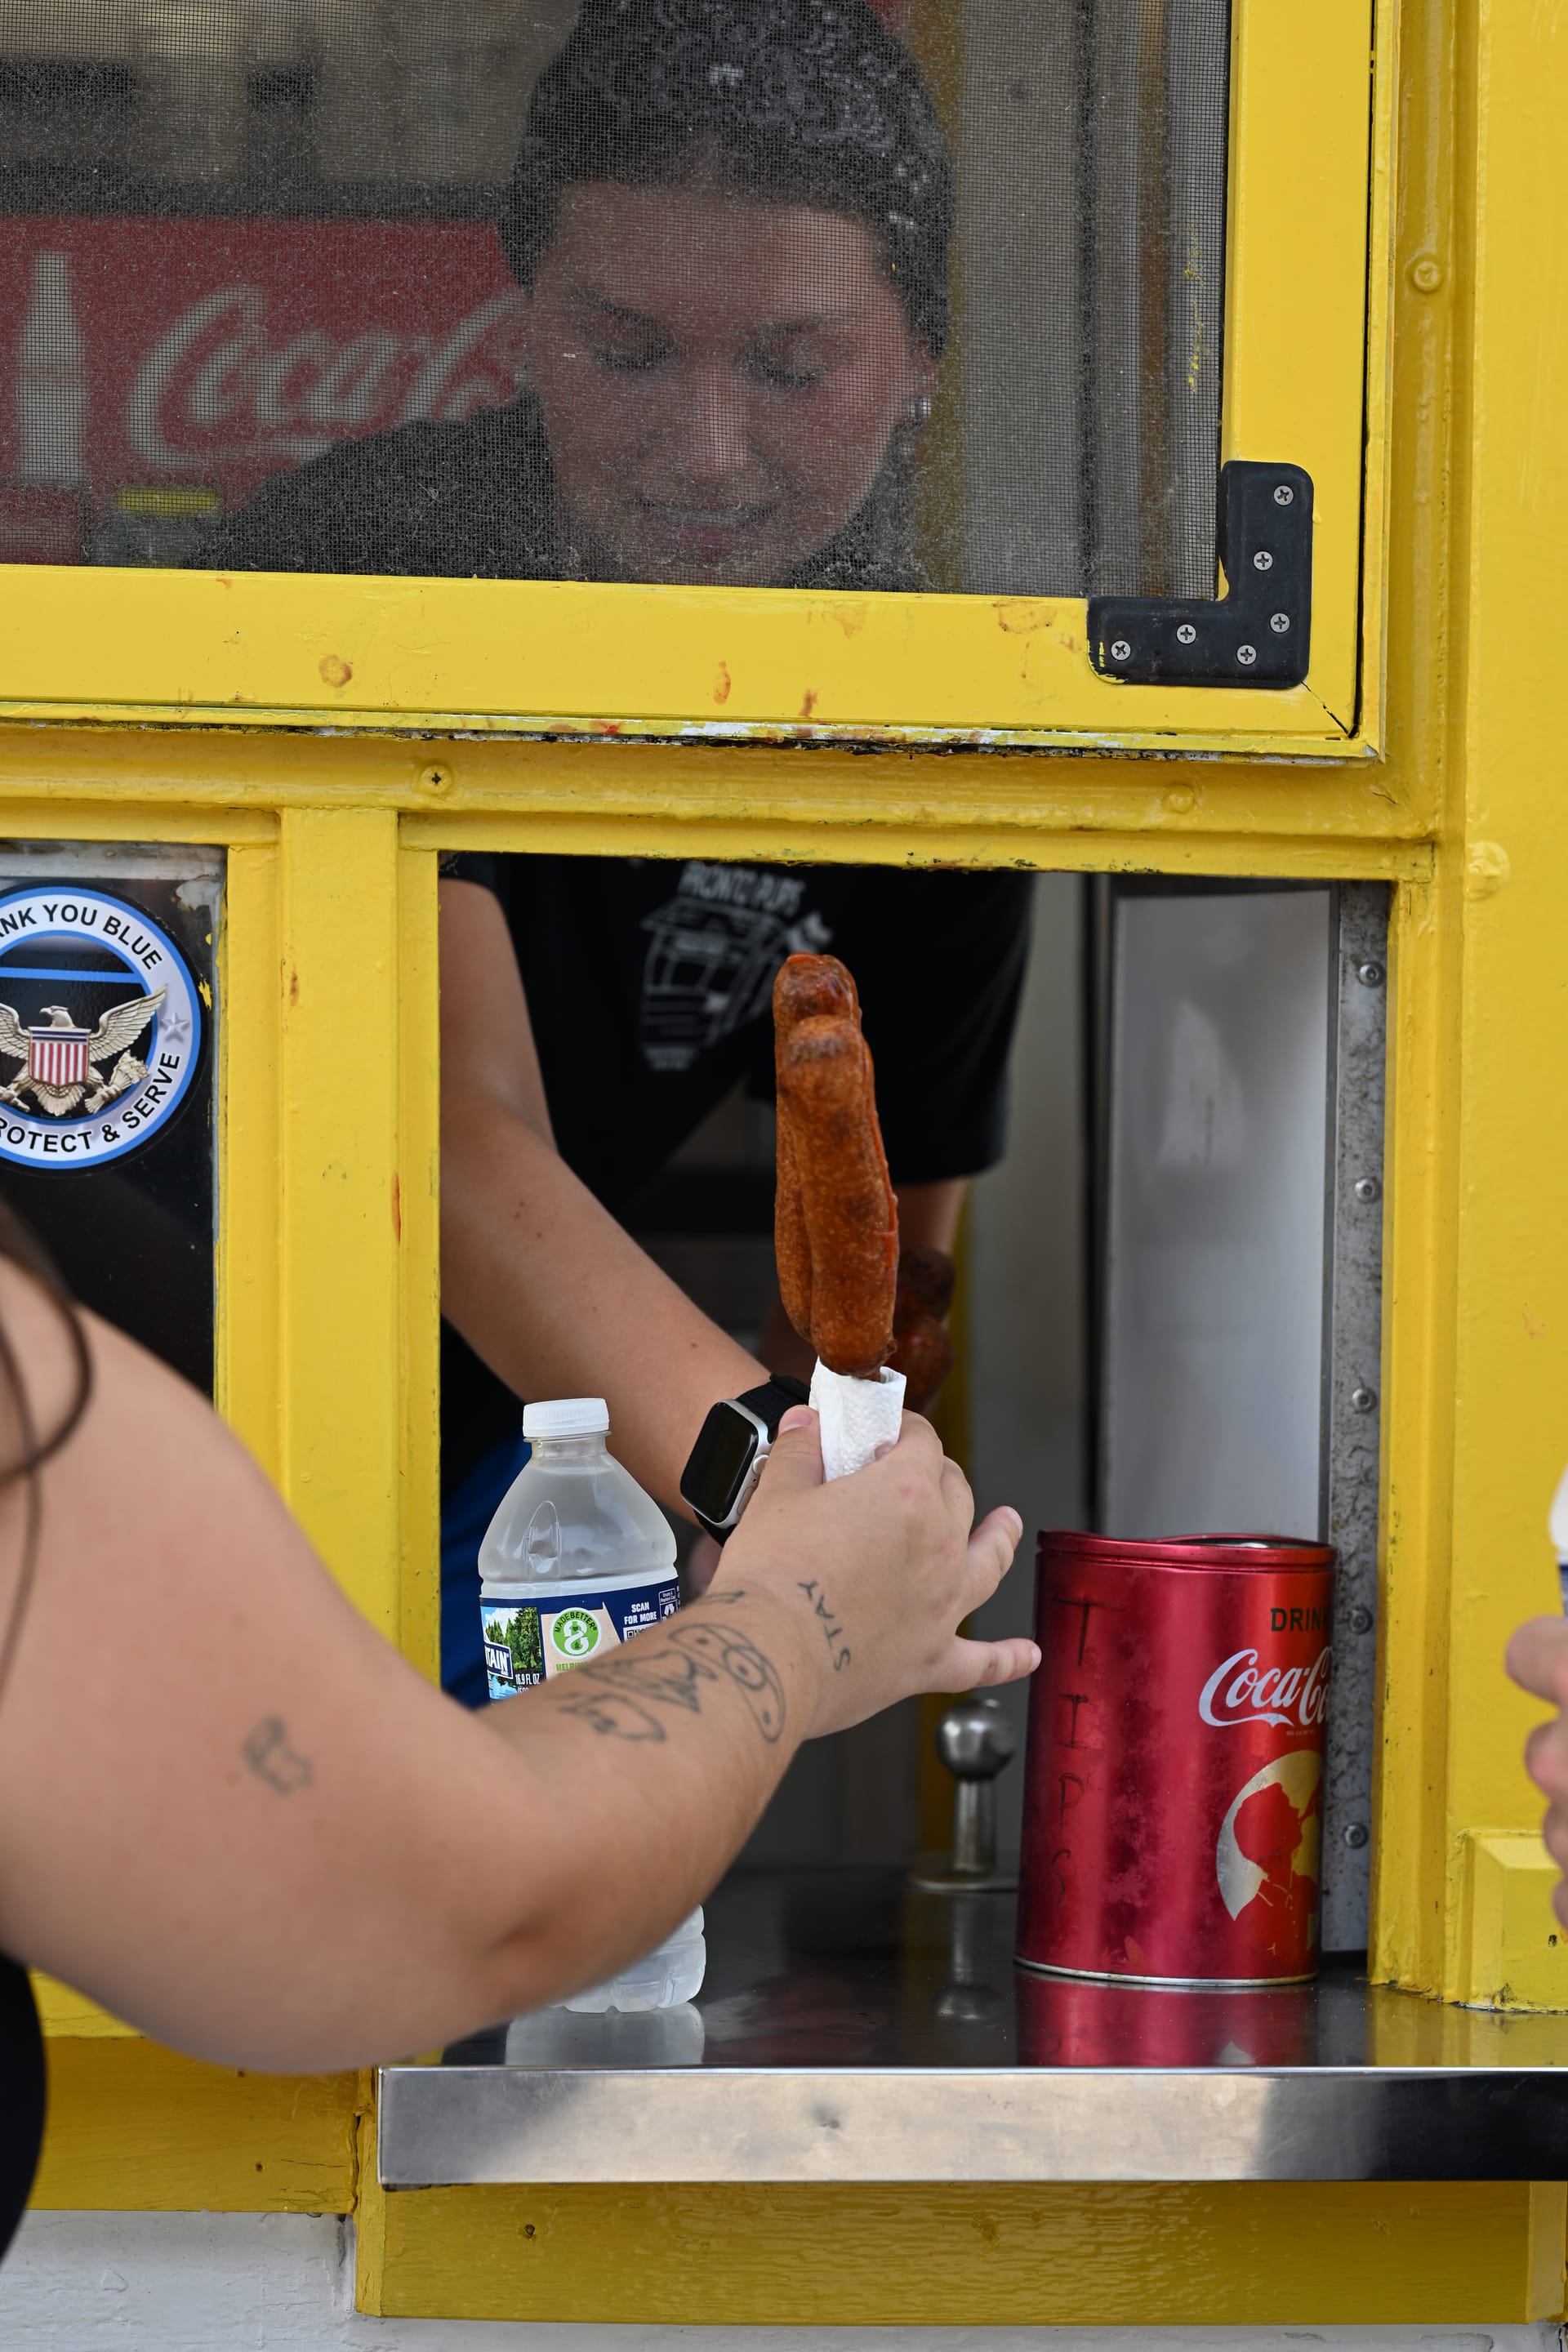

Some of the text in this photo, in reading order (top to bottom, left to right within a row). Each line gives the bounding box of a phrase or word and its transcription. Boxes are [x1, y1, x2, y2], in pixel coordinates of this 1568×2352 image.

[0, 904, 163, 970] NK YOU BLUE
[101, 1124, 121, 1143] &
[122, 1053, 180, 1130] SERVE
[624, 1611, 657, 1625] FOR MORE
[630, 1601, 650, 1613] SCAN
[797, 1579, 851, 1672] STAY
[515, 1673, 525, 1686] 16.9
[525, 1673, 532, 1686] FL
[532, 1673, 541, 1685] OZ
